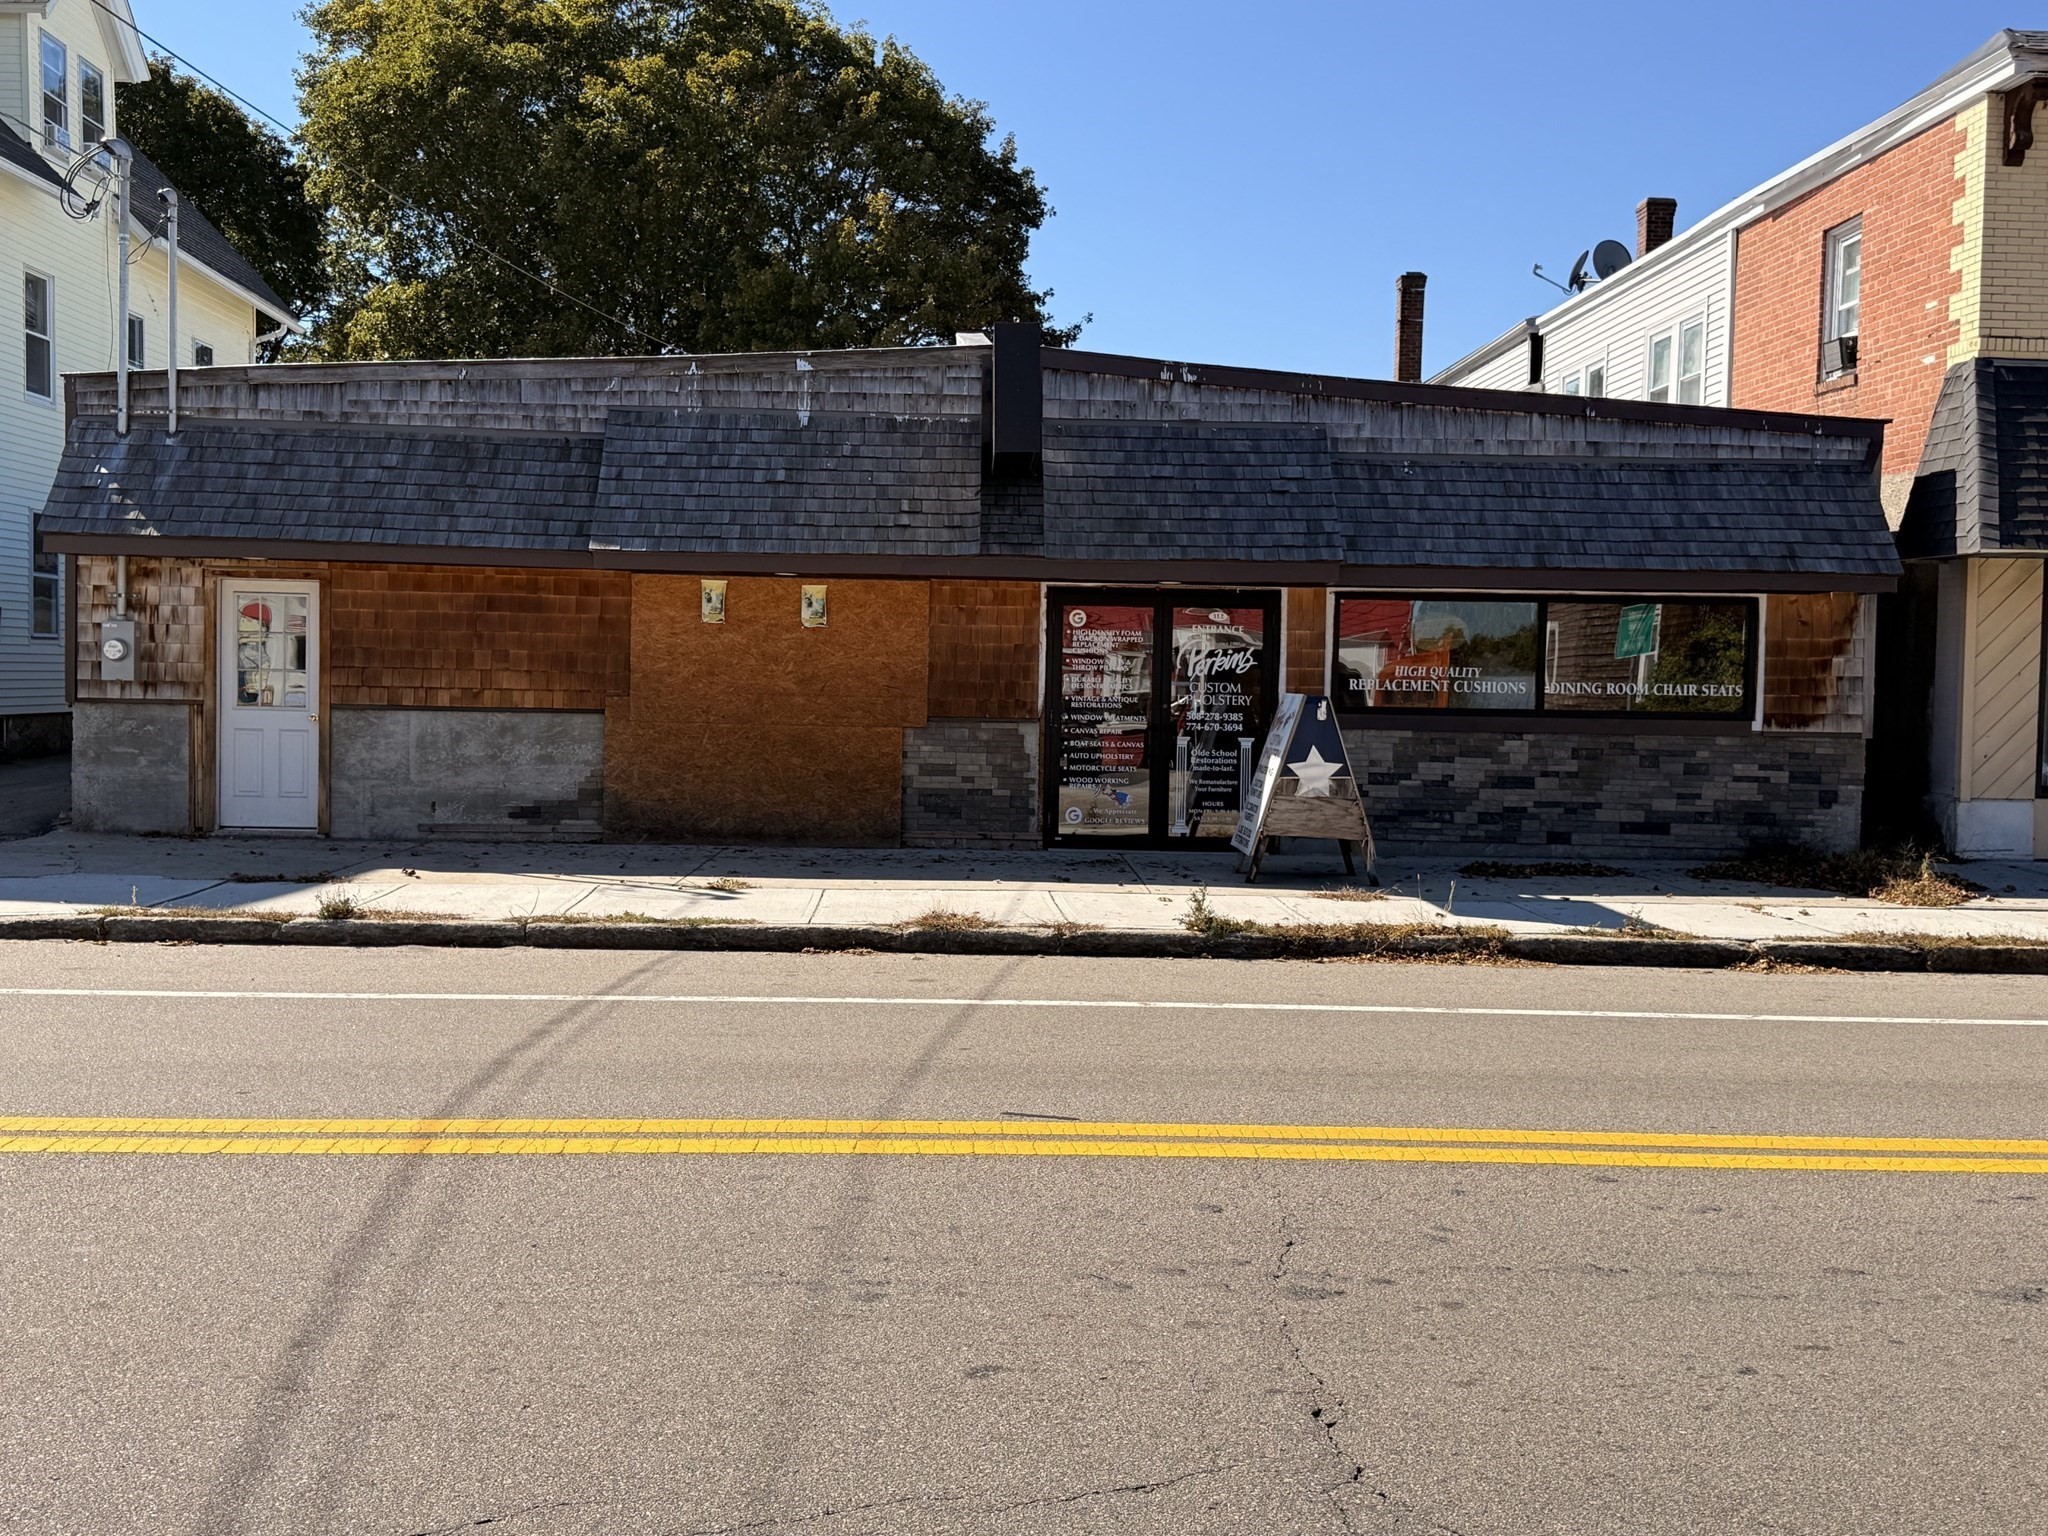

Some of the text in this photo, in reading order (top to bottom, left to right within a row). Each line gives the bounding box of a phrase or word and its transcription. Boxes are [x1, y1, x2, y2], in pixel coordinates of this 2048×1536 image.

[1192, 624, 1244, 634] ENTRANCE
[1395, 665, 1482, 678] HIGH QUALITY
[1189, 682, 1241, 693] CUSTOM
[1349, 678, 1527, 694] REPLACEMENT CUSHIONS
[1550, 682, 1743, 697] DINING ROOM CHAIR SEATS
[1108, 696, 1139, 704] ANTIQUE
[1104, 714, 1147, 722] TREATMENTS
[1186, 712, 1244, 721] 508-278-9385
[1070, 727, 1123, 735] CANVAS REPAIR
[1186, 722, 1244, 732] 774-670-3694
[1090, 752, 1135, 760] UPHOLSTERY
[1190, 749, 1238, 757] Olde School
[1069, 776, 1094, 784] WOOD
[1105, 807, 1137, 816] Appreciate
[1115, 817, 1146, 825] REVIEWS
